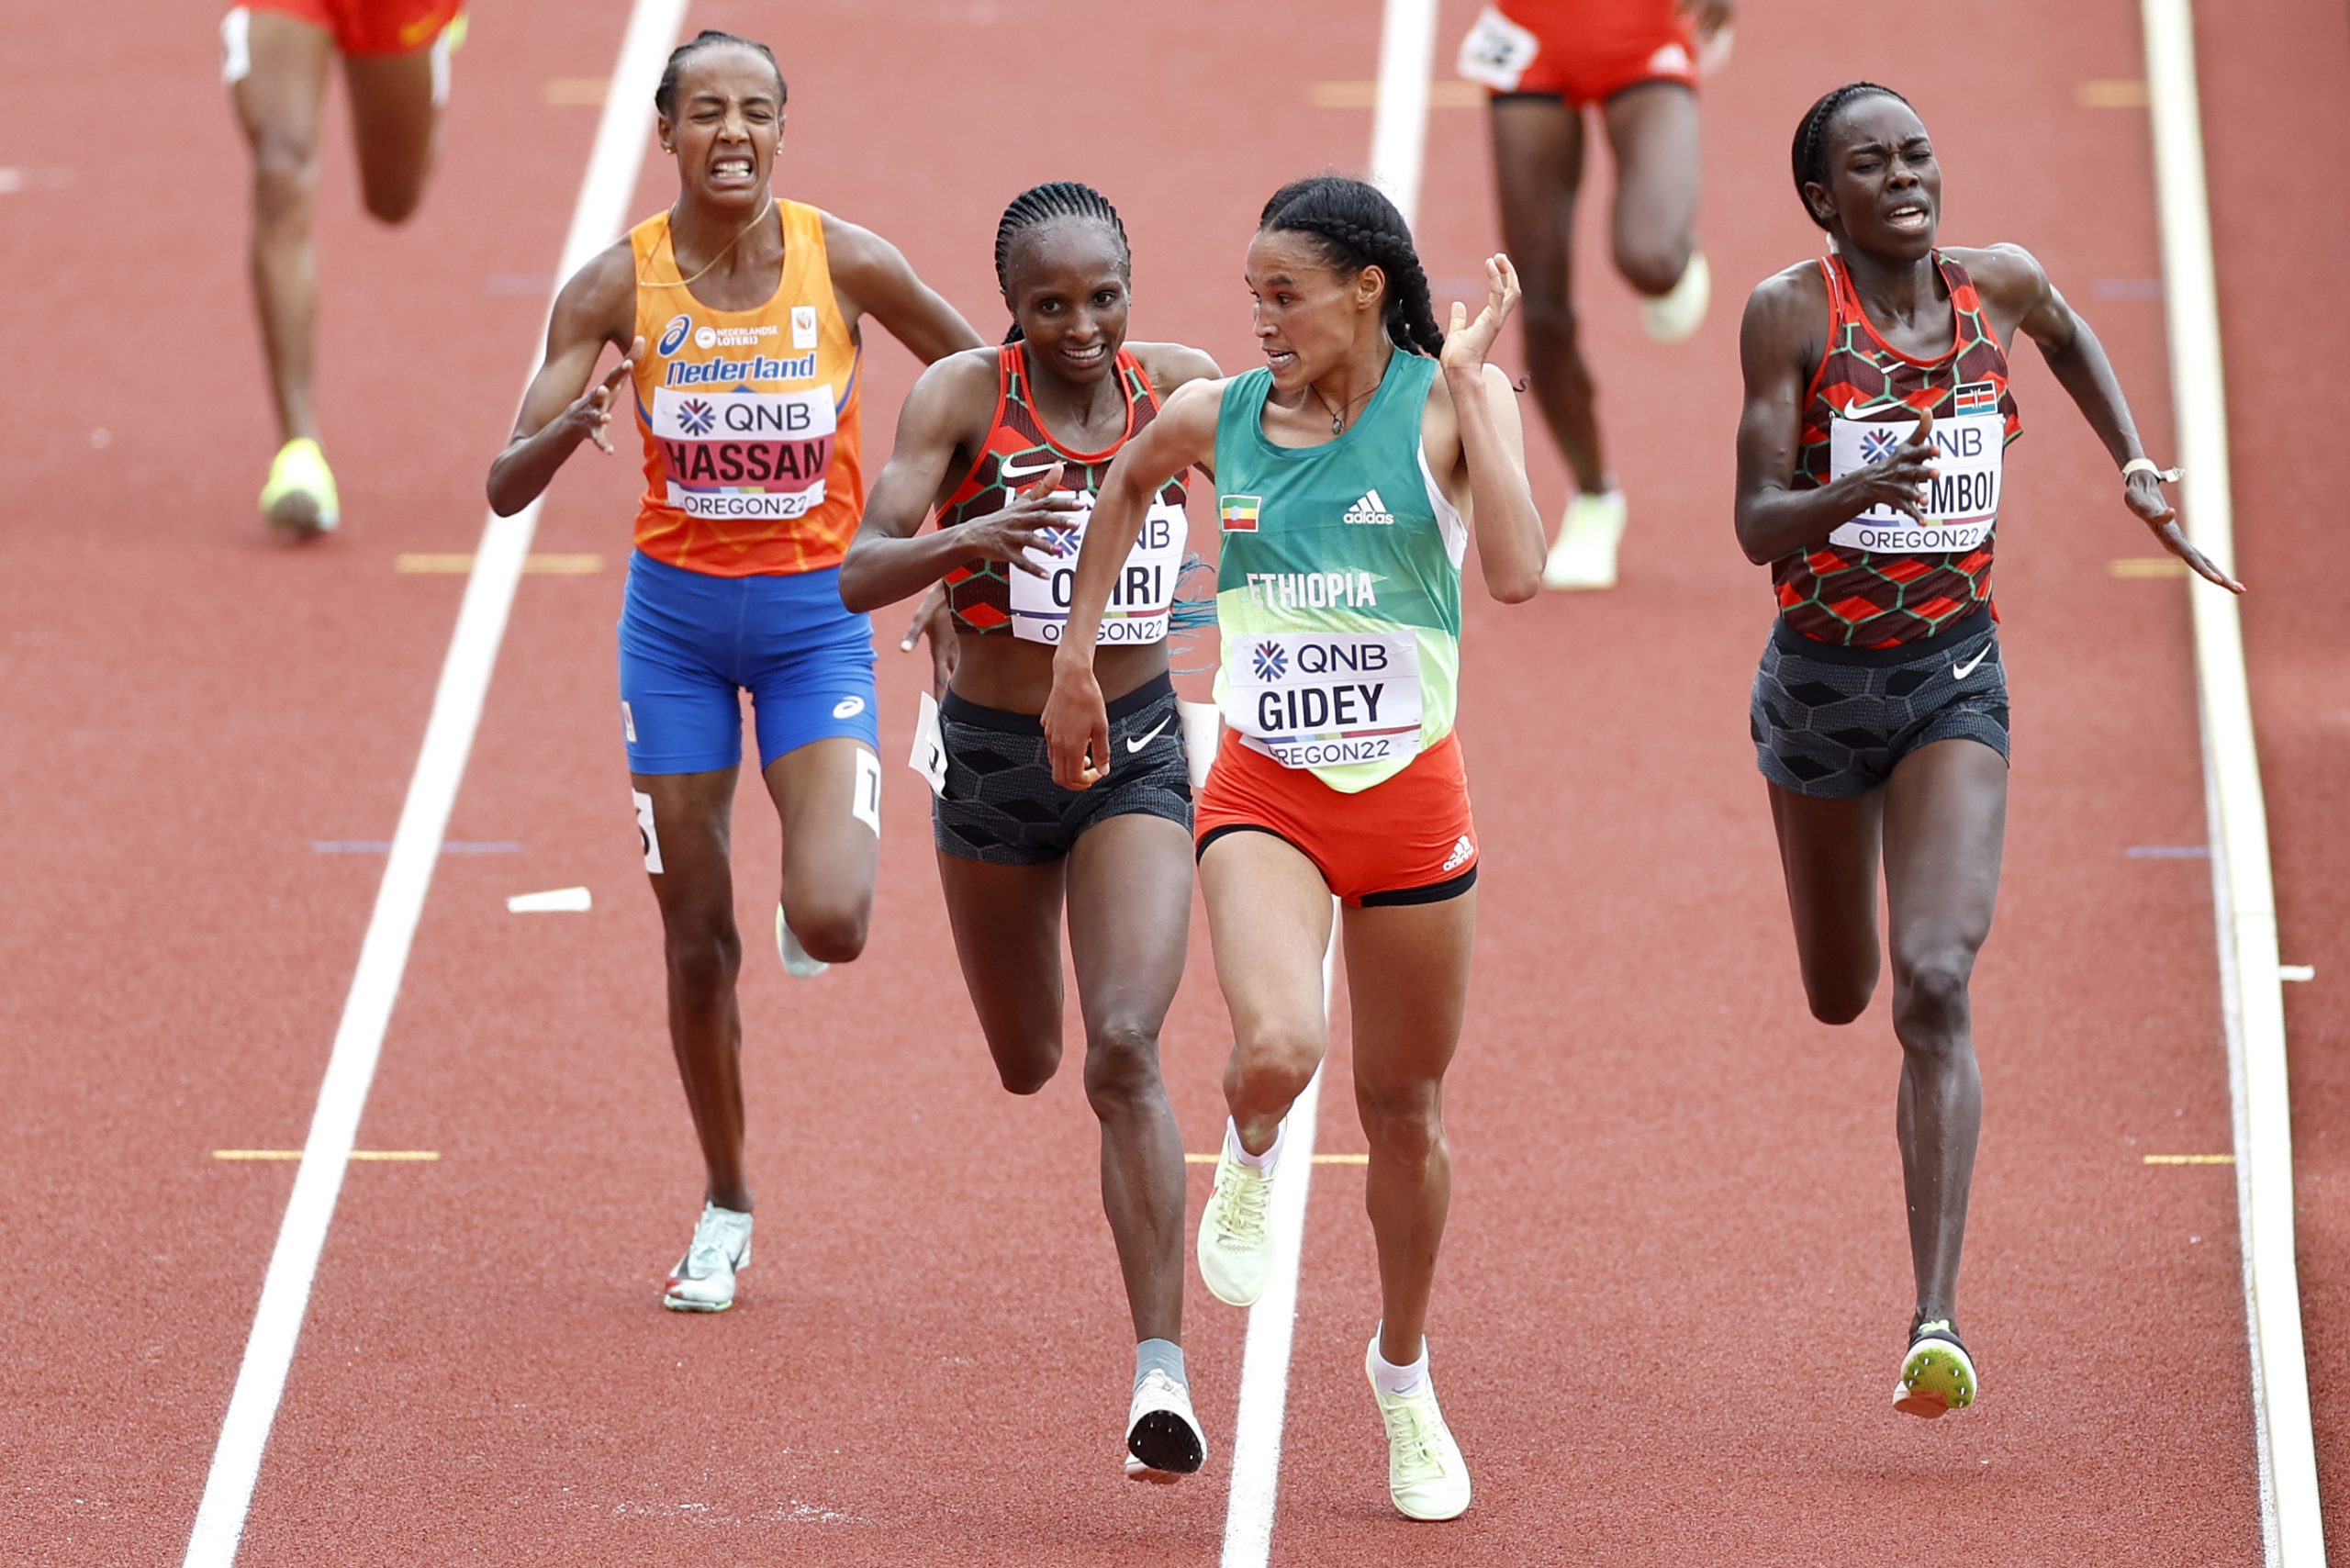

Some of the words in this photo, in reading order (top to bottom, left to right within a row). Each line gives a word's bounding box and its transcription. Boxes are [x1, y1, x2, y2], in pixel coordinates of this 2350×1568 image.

[717, 325, 778, 336] NEDERLANDSE
[717, 335, 758, 346] LOTERIJ
[725, 403, 811, 431] QNB
[1926, 427, 1983, 462] NB
[665, 440, 825, 481] HASSAN
[684, 495, 808, 515] OREGON22
[1343, 510, 1394, 525] adidas
[1859, 528, 1979, 549] OREGON22
[1052, 566, 1161, 608] OIRI
[1246, 573, 1377, 608] ETHIOPIA
[1296, 643, 1389, 674] QNB
[1258, 683, 1384, 732] GIDEY
